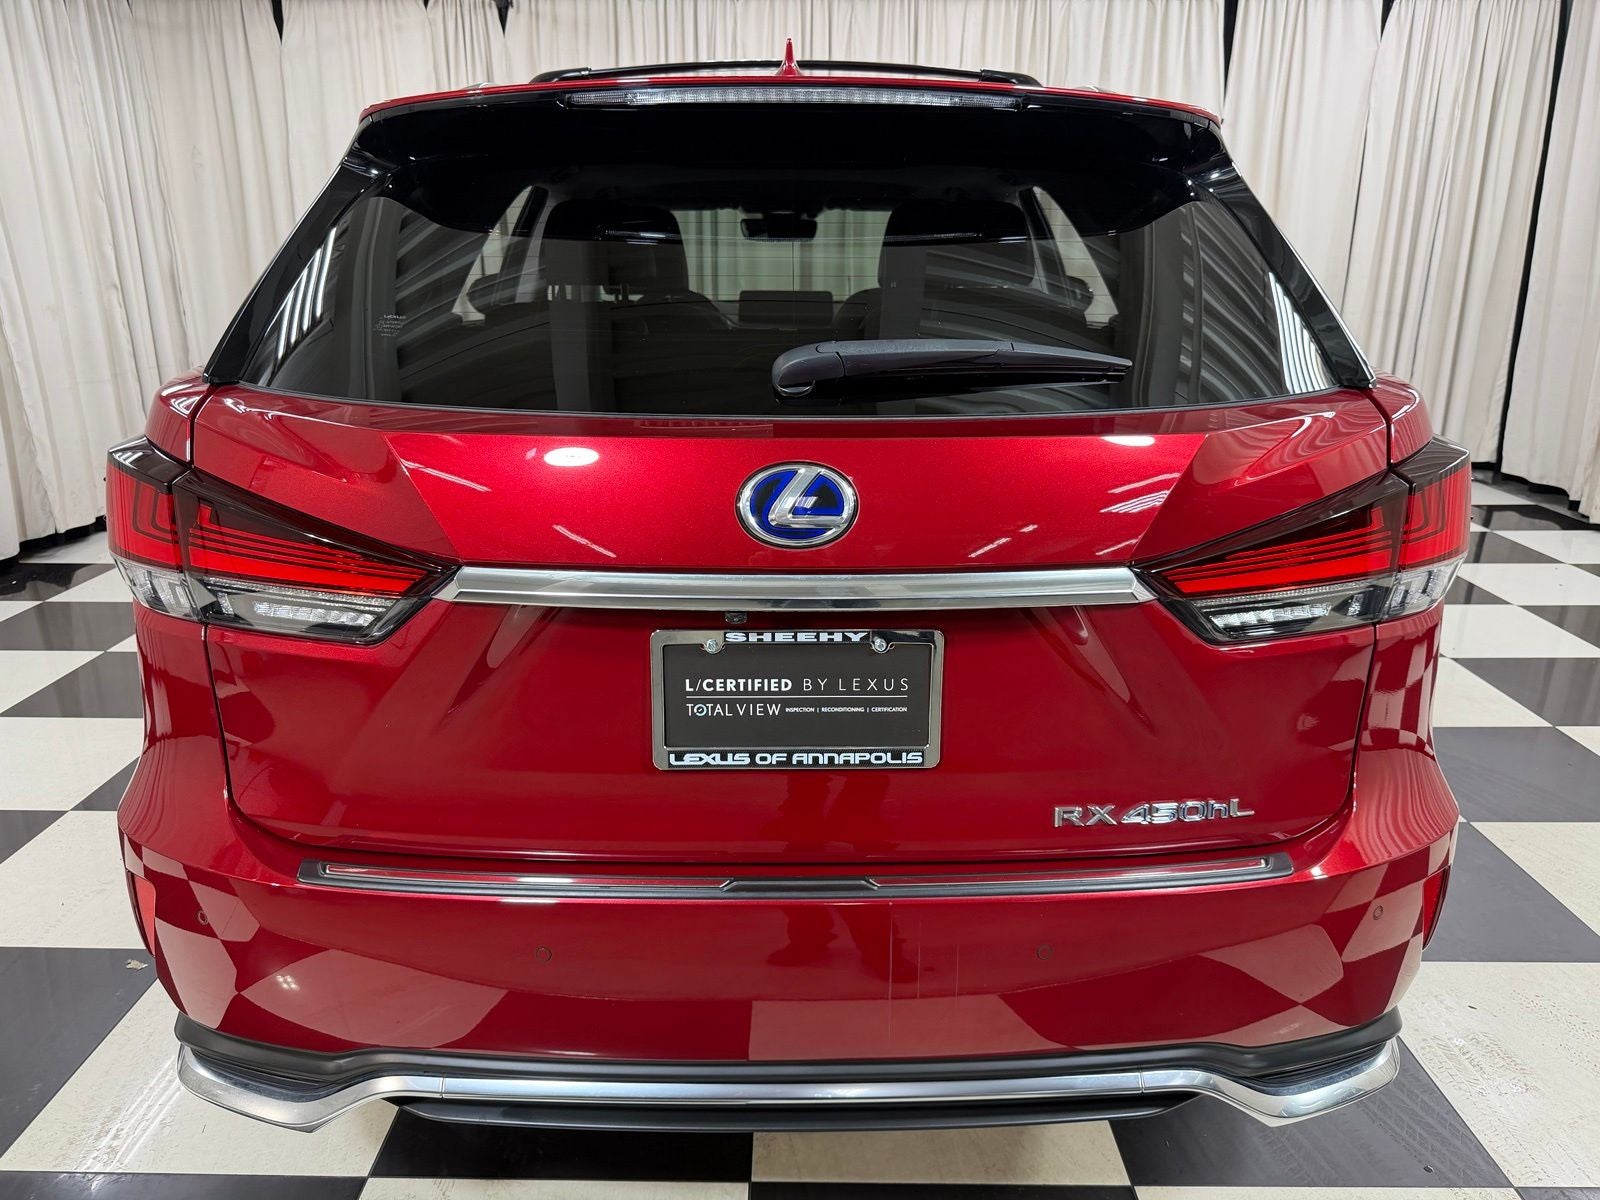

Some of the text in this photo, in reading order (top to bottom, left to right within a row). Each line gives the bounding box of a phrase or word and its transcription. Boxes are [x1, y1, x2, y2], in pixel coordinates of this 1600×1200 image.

[725, 632, 867, 643] SHEEHY
[685, 678, 909, 692] L/CERTIFIED BY LEXUS
[686, 703, 733, 717] TOTAL
[736, 703, 781, 716] VIEW
[669, 752, 923, 766] LEXUS OF ANNAPOLIS
[1053, 804, 1118, 828] RX
